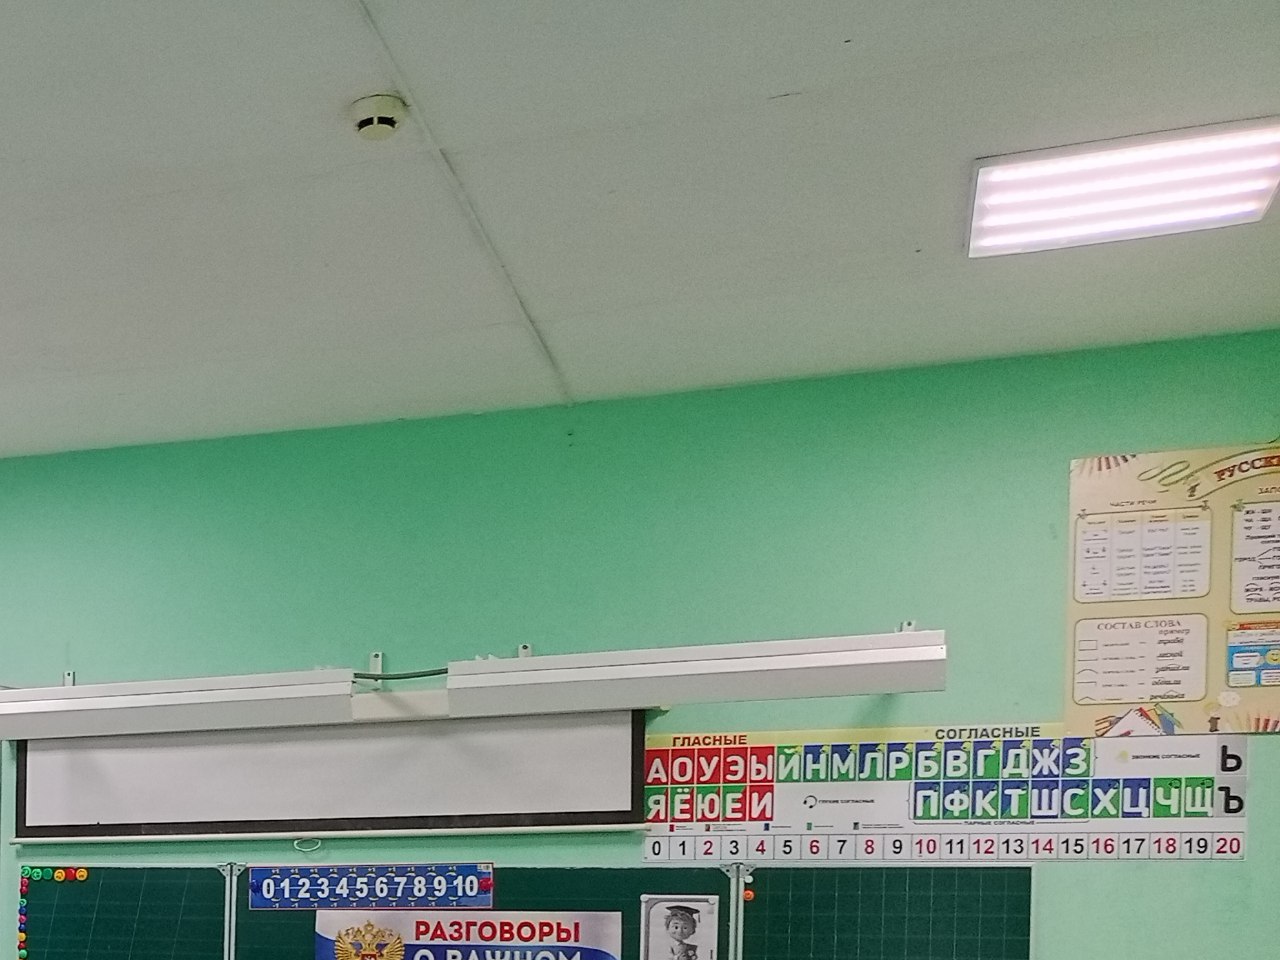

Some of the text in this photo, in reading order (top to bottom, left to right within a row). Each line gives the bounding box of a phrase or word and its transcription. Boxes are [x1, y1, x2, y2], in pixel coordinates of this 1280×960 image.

[672, 735, 748, 747] ГЛАСНЫЕ
[935, 726, 1040, 740] СОГЛАСНЫЕ
[652, 838, 1240, 855] 0 1 2 3 4 5 6 7 8 9 10 11 12 13 14 15 16 17 18 19 20
[262, 875, 478, 898] 0 1 2 3 4 5 6 7 8 9 10
[415, 920, 580, 943] РАЗГОВОРЫ
